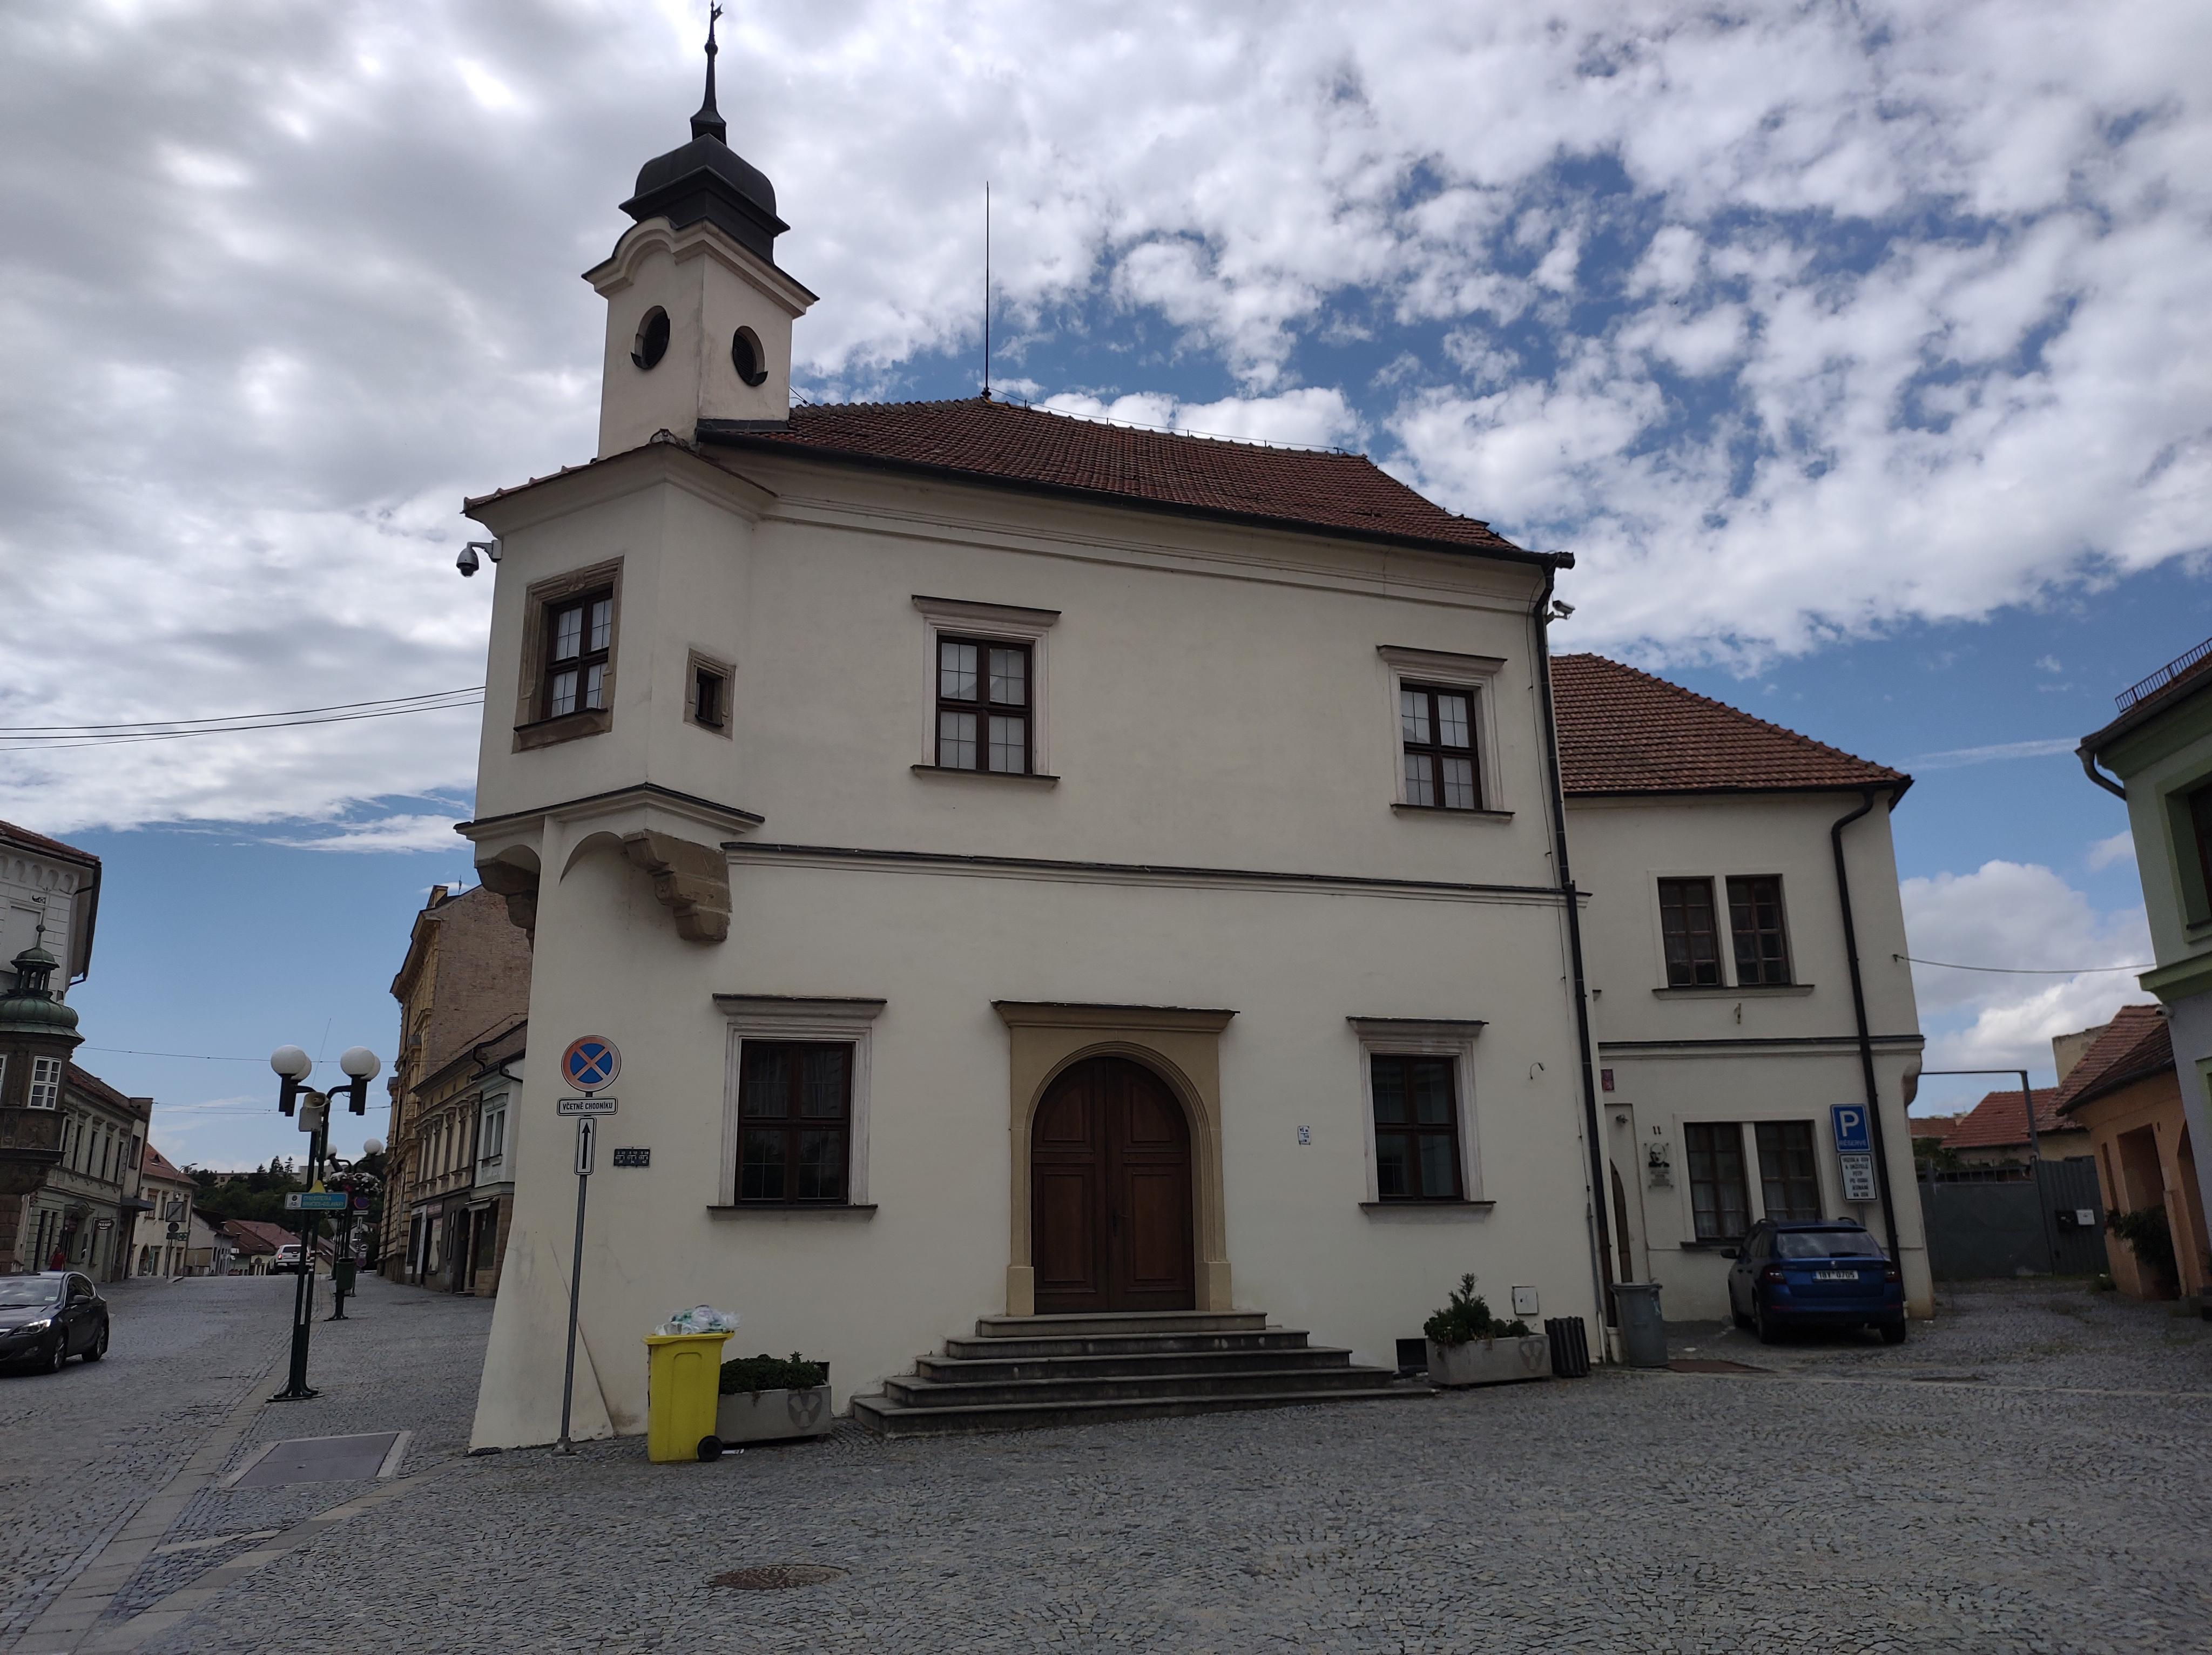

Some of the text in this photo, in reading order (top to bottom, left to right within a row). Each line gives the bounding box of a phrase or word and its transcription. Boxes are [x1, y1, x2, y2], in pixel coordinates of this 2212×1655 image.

[563, 1102, 613, 1111] VČETNĚ CHODNÍKU
[1839, 1110, 1859, 1137] P
